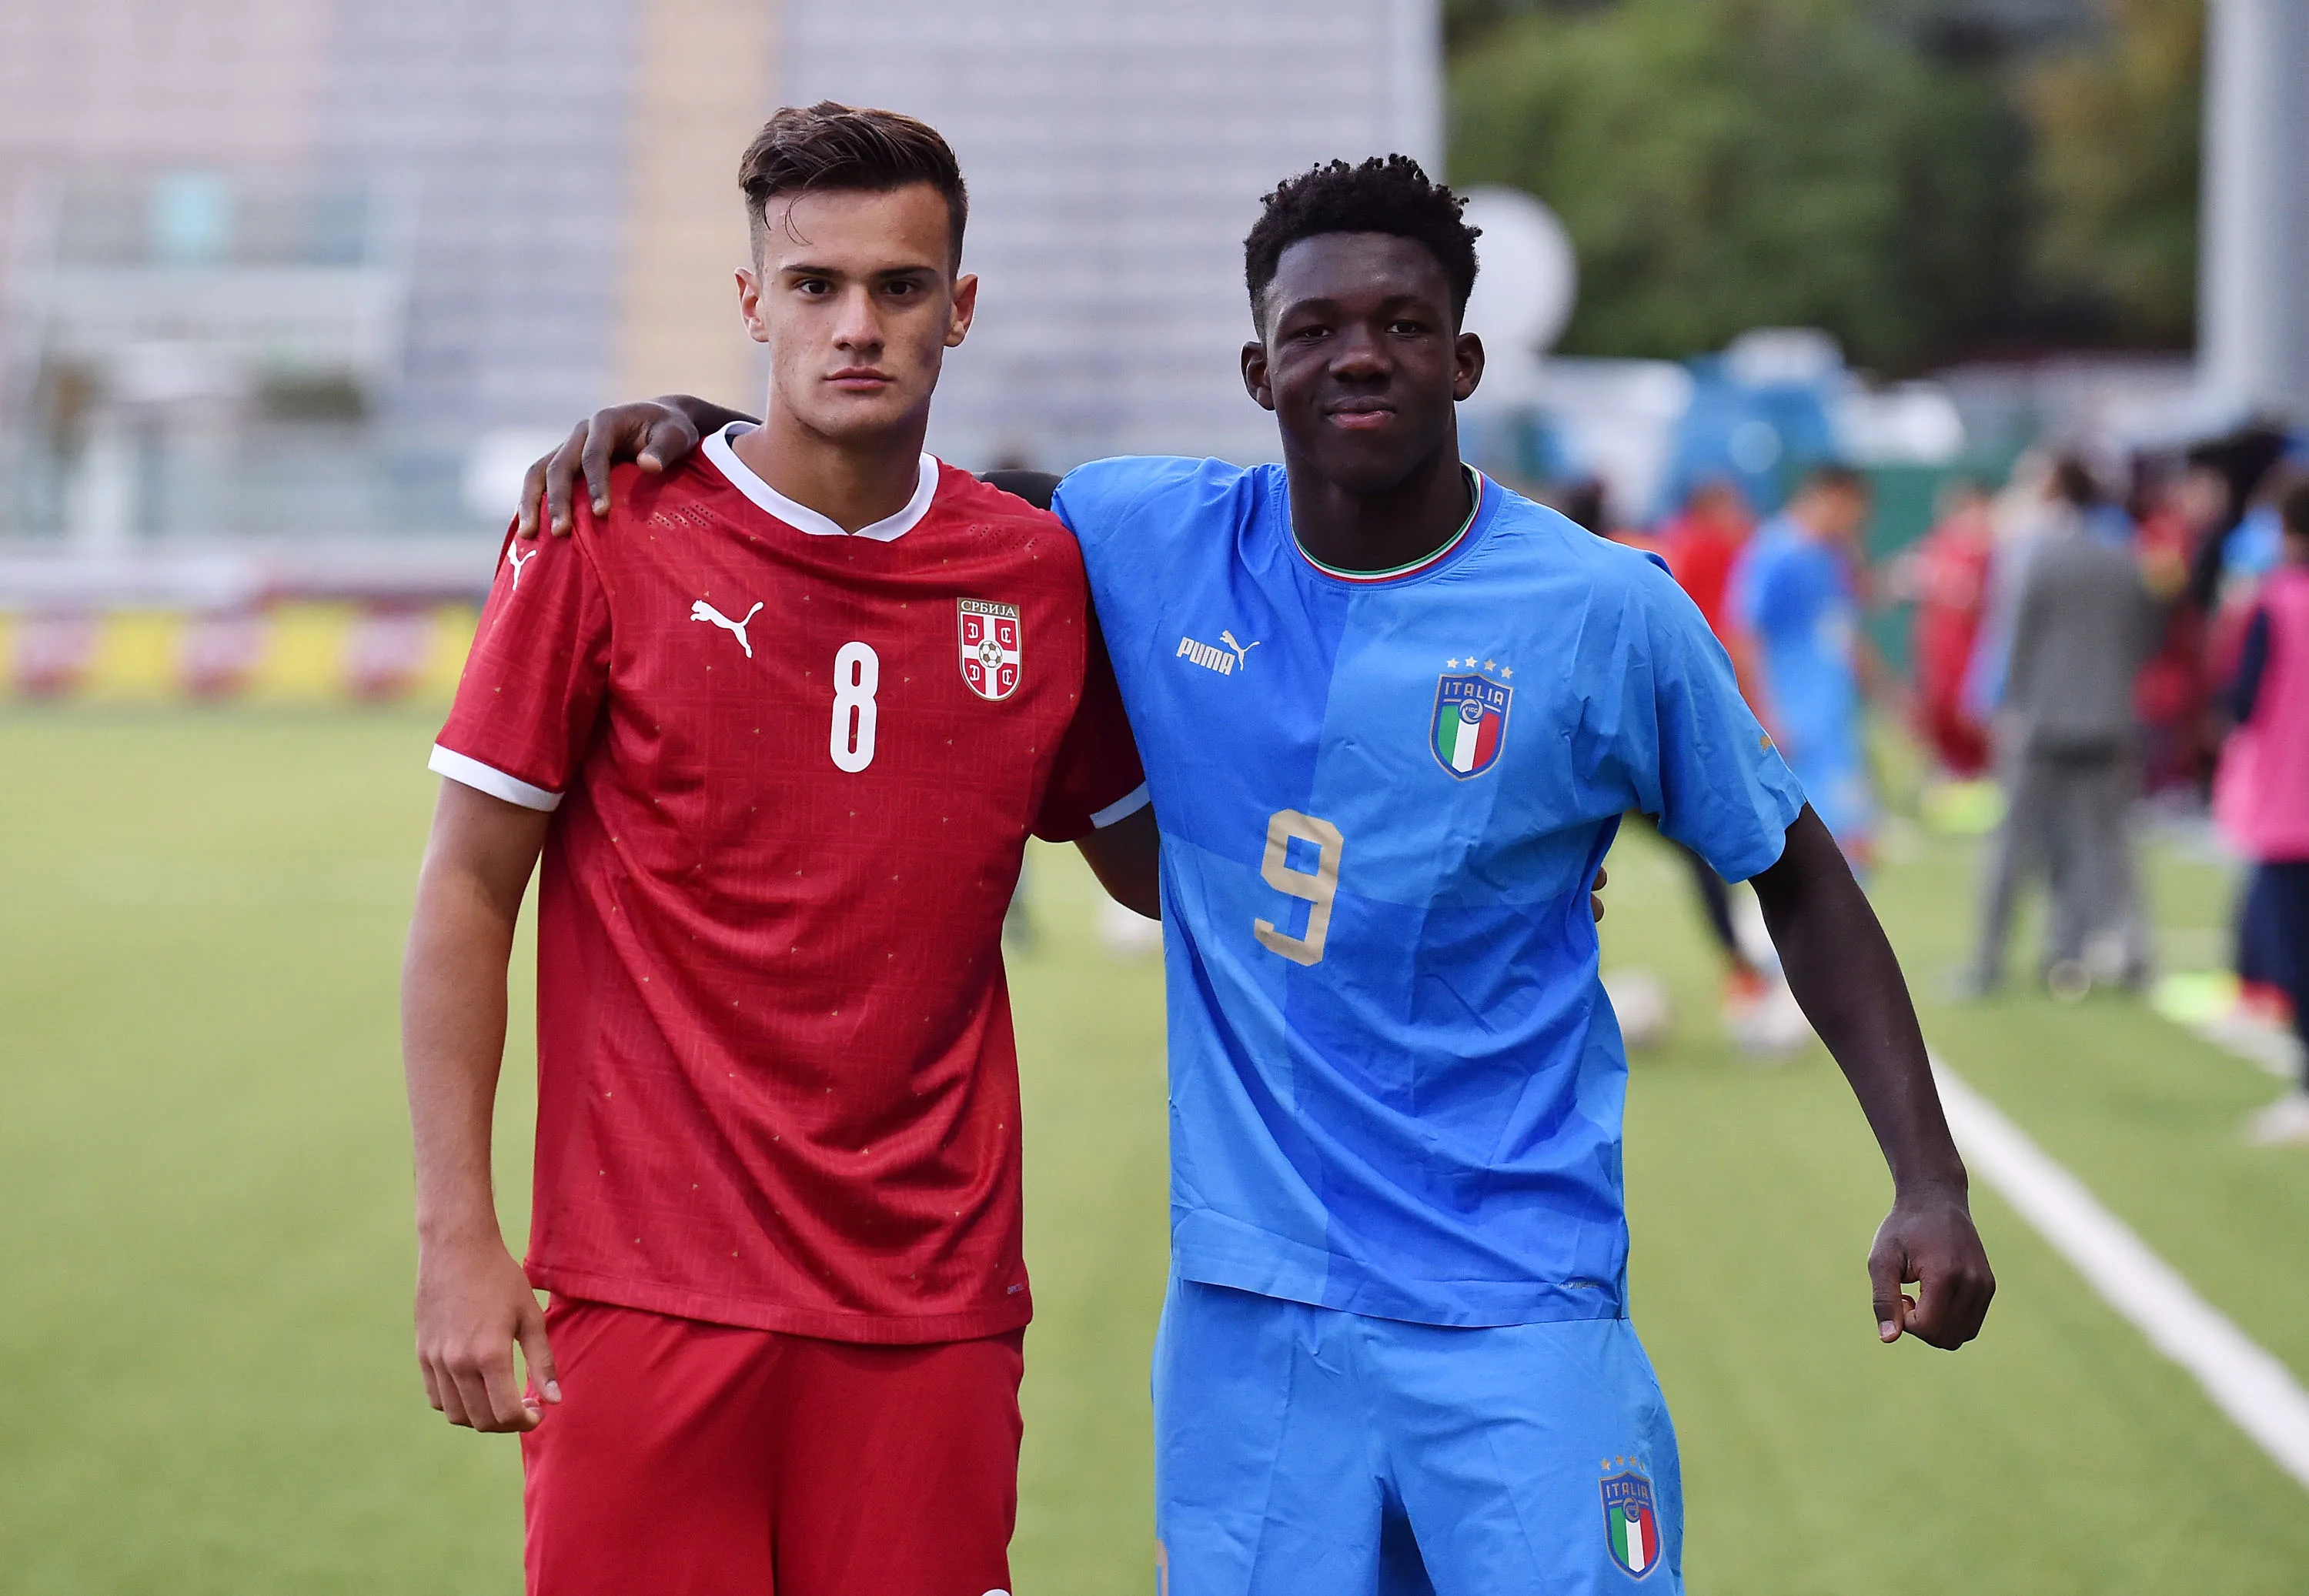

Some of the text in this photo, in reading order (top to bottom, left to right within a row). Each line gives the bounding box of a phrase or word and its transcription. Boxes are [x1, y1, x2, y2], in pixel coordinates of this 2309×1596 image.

[961, 600, 1016, 616] СРБИЈА
[1176, 636, 1236, 676] PUMA
[830, 641, 880, 773] 8
[1444, 682, 1505, 706] ITALIA
[1254, 808, 1345, 967] 9
[1606, 1482, 1649, 1499] ITALIA
